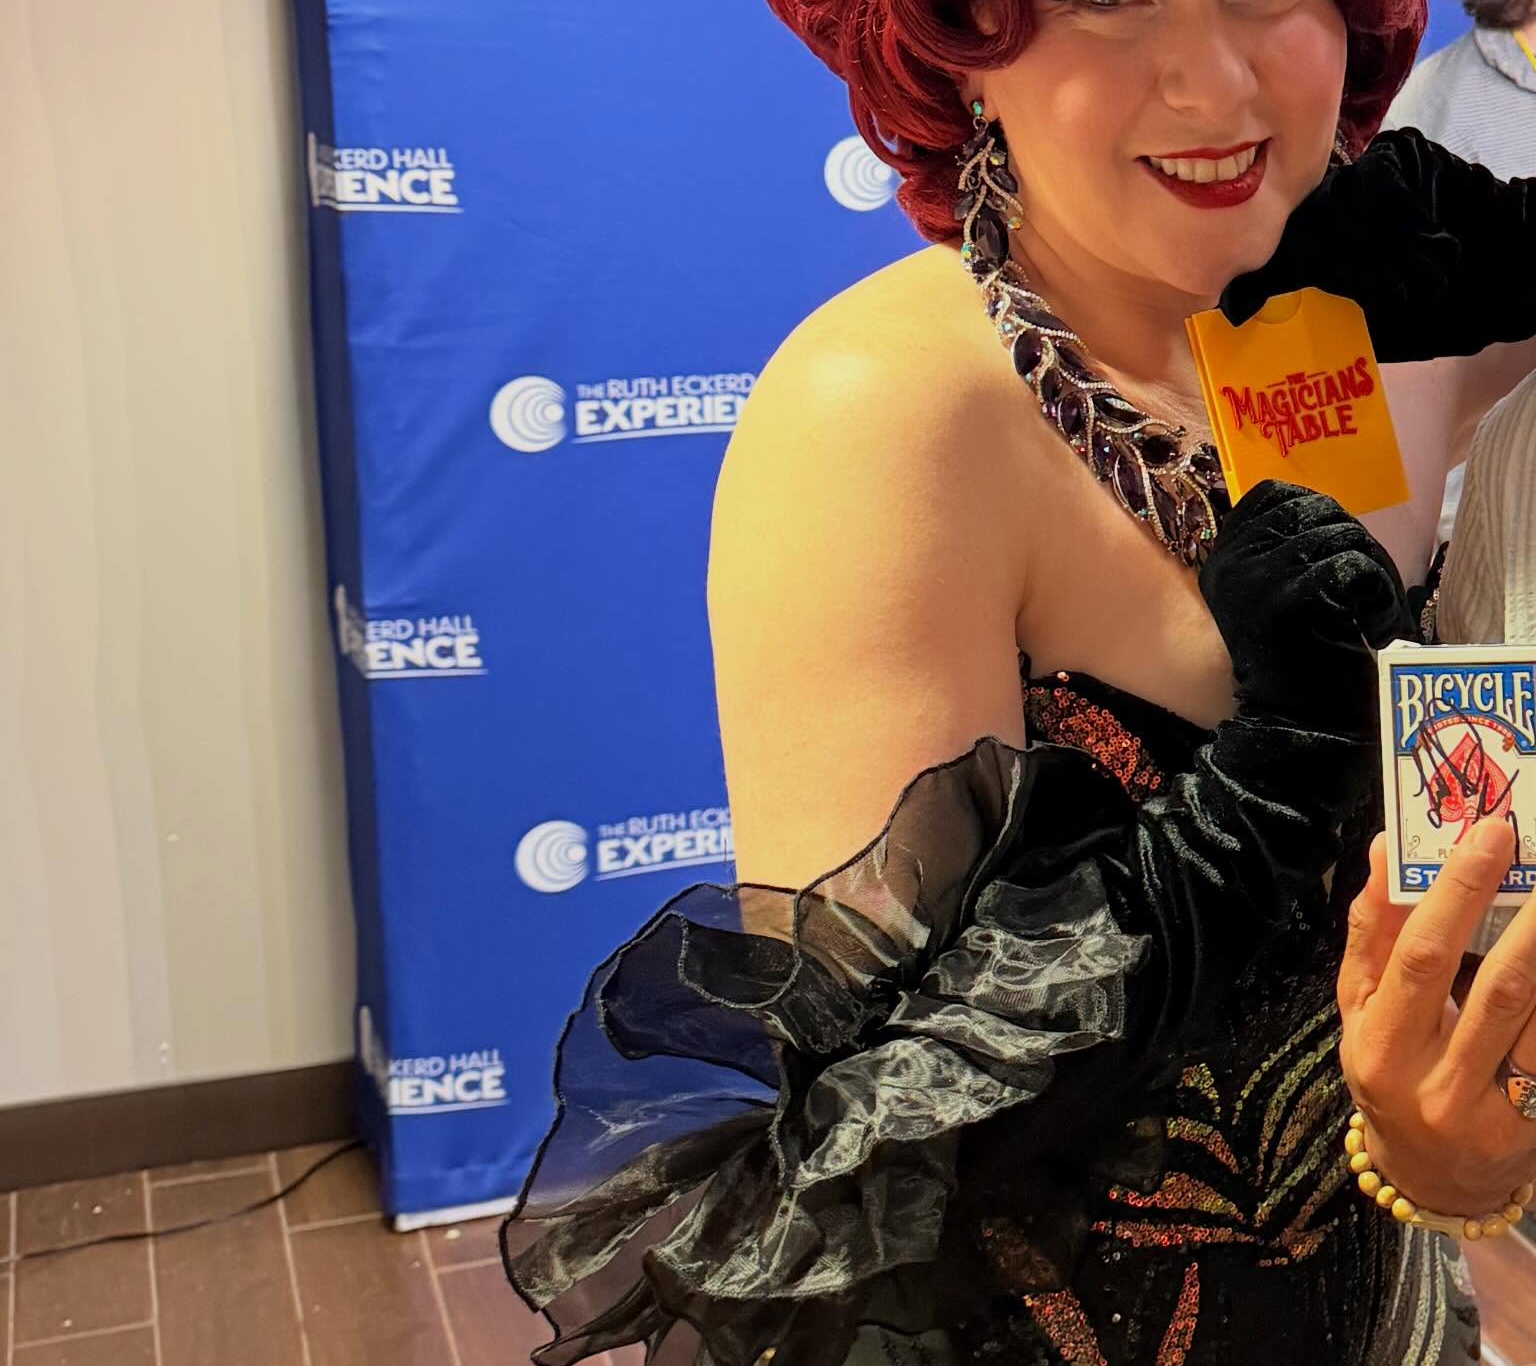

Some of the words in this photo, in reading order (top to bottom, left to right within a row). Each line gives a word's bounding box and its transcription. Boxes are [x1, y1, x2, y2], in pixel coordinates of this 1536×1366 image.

[392, 148, 453, 169] HALL
[607, 376, 668, 398] RUTH
[672, 372, 756, 395] ECKERD
[1220, 357, 1375, 430] MAGICIANS
[1263, 405, 1357, 457] TABLE
[418, 615, 477, 637] HALL
[1397, 671, 1535, 747] BICYCLE
[628, 812, 685, 835] RUTH
[449, 1049, 504, 1072] HALL
